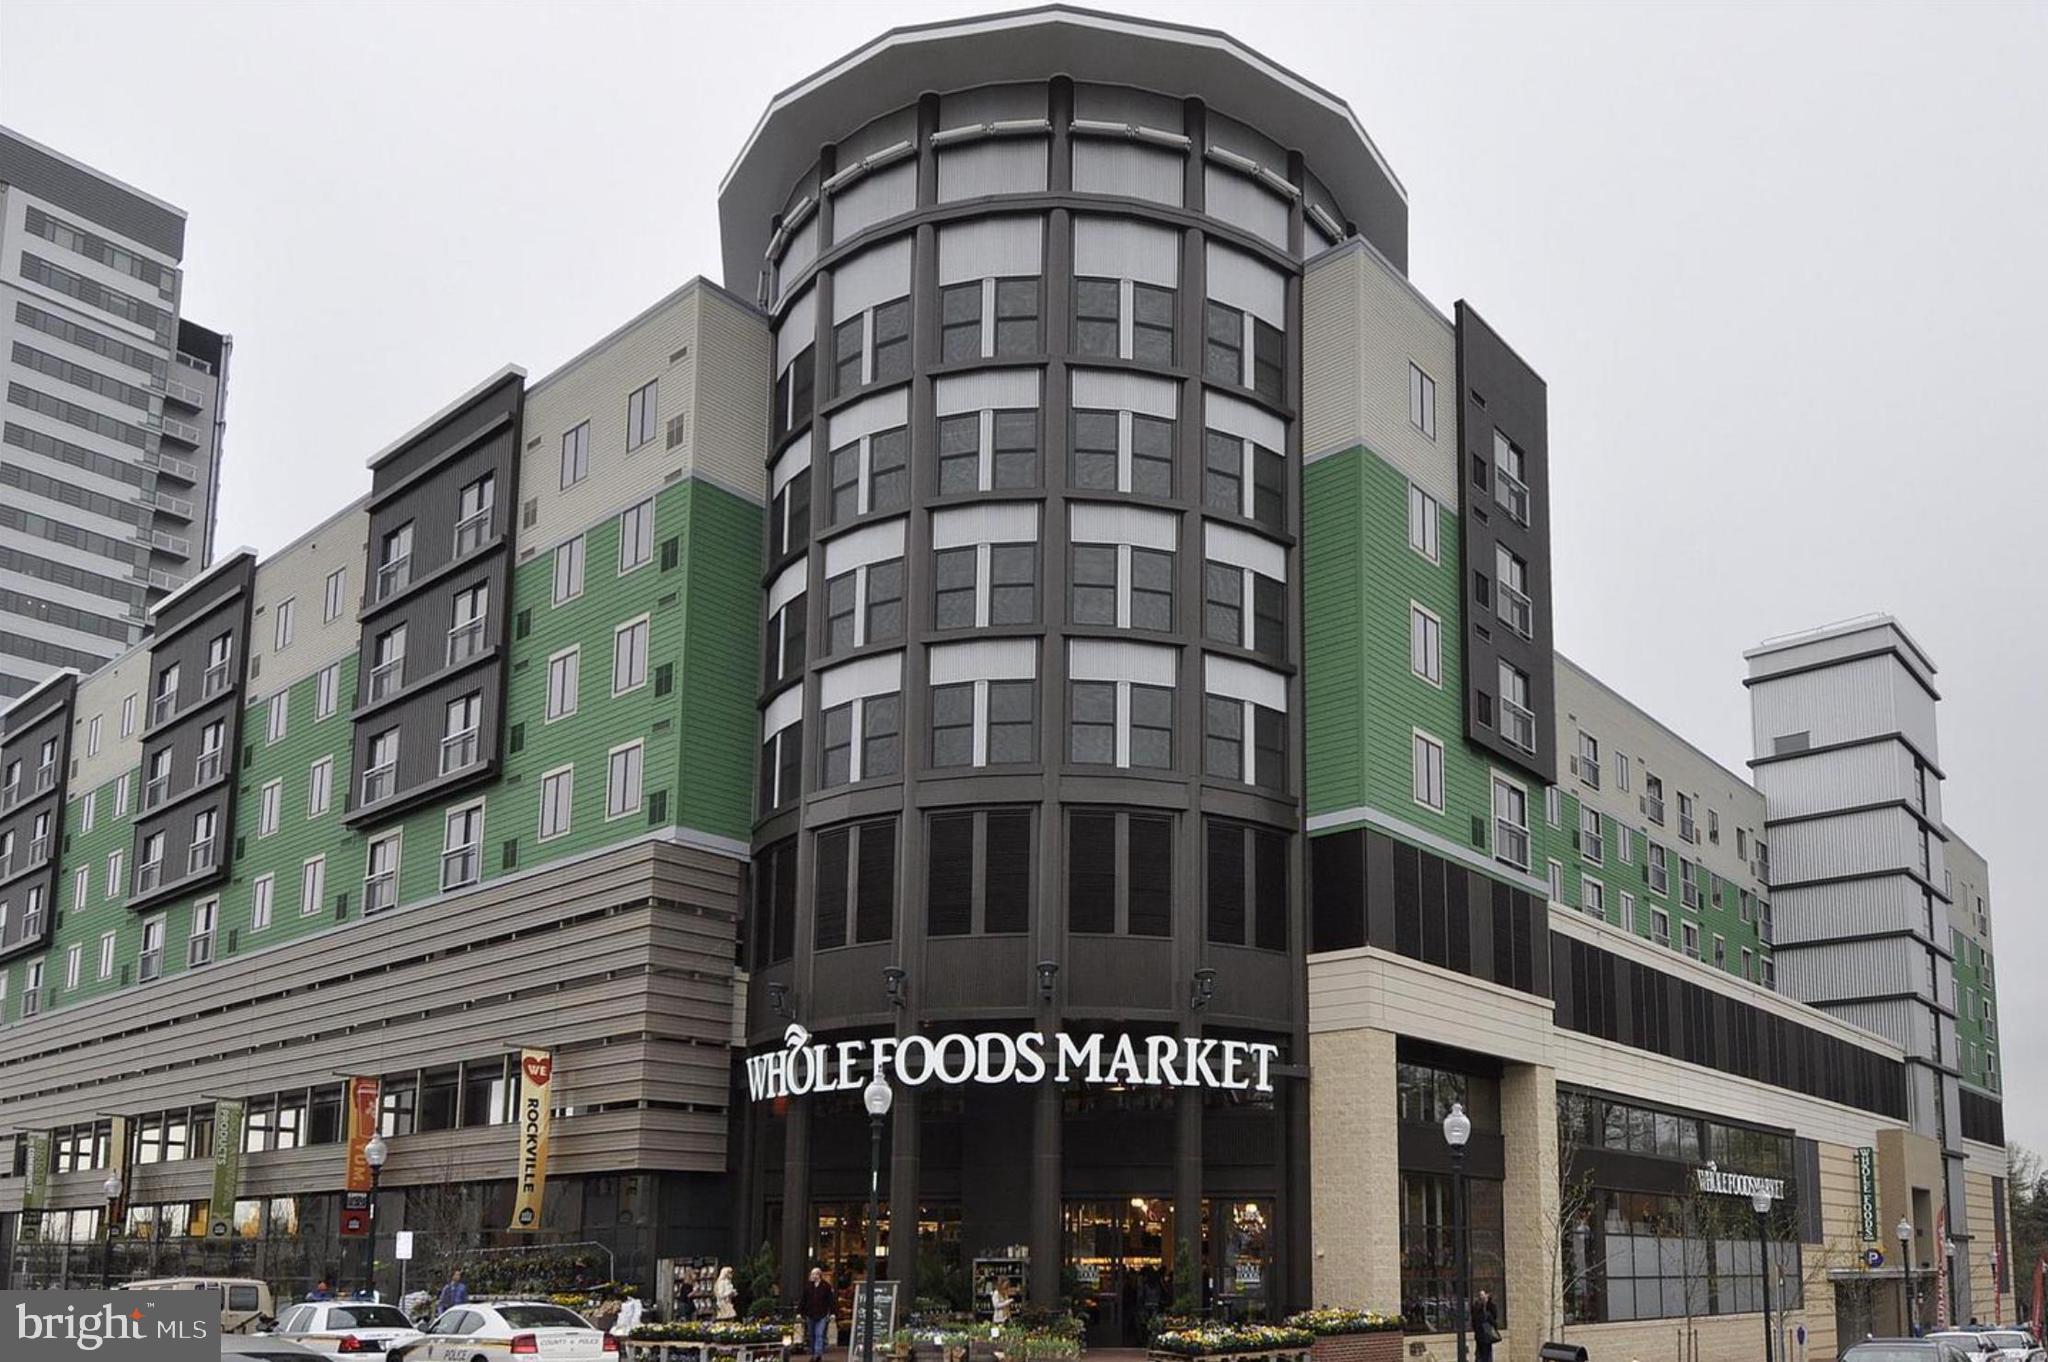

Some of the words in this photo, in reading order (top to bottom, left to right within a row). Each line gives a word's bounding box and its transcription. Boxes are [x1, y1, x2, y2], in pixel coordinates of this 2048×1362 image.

[527, 1063, 548, 1077] WE
[871, 1032, 1043, 1085] FOODS
[1054, 1033, 1279, 1092] MARKET
[217, 1109, 230, 1166] PRODUCTS
[523, 1098, 540, 1193] ROCKVILLE
[1728, 1173, 1756, 1197] FOODS
[1859, 1147, 1873, 1193] WHOLE
[1863, 1195, 1876, 1240] FOODS
